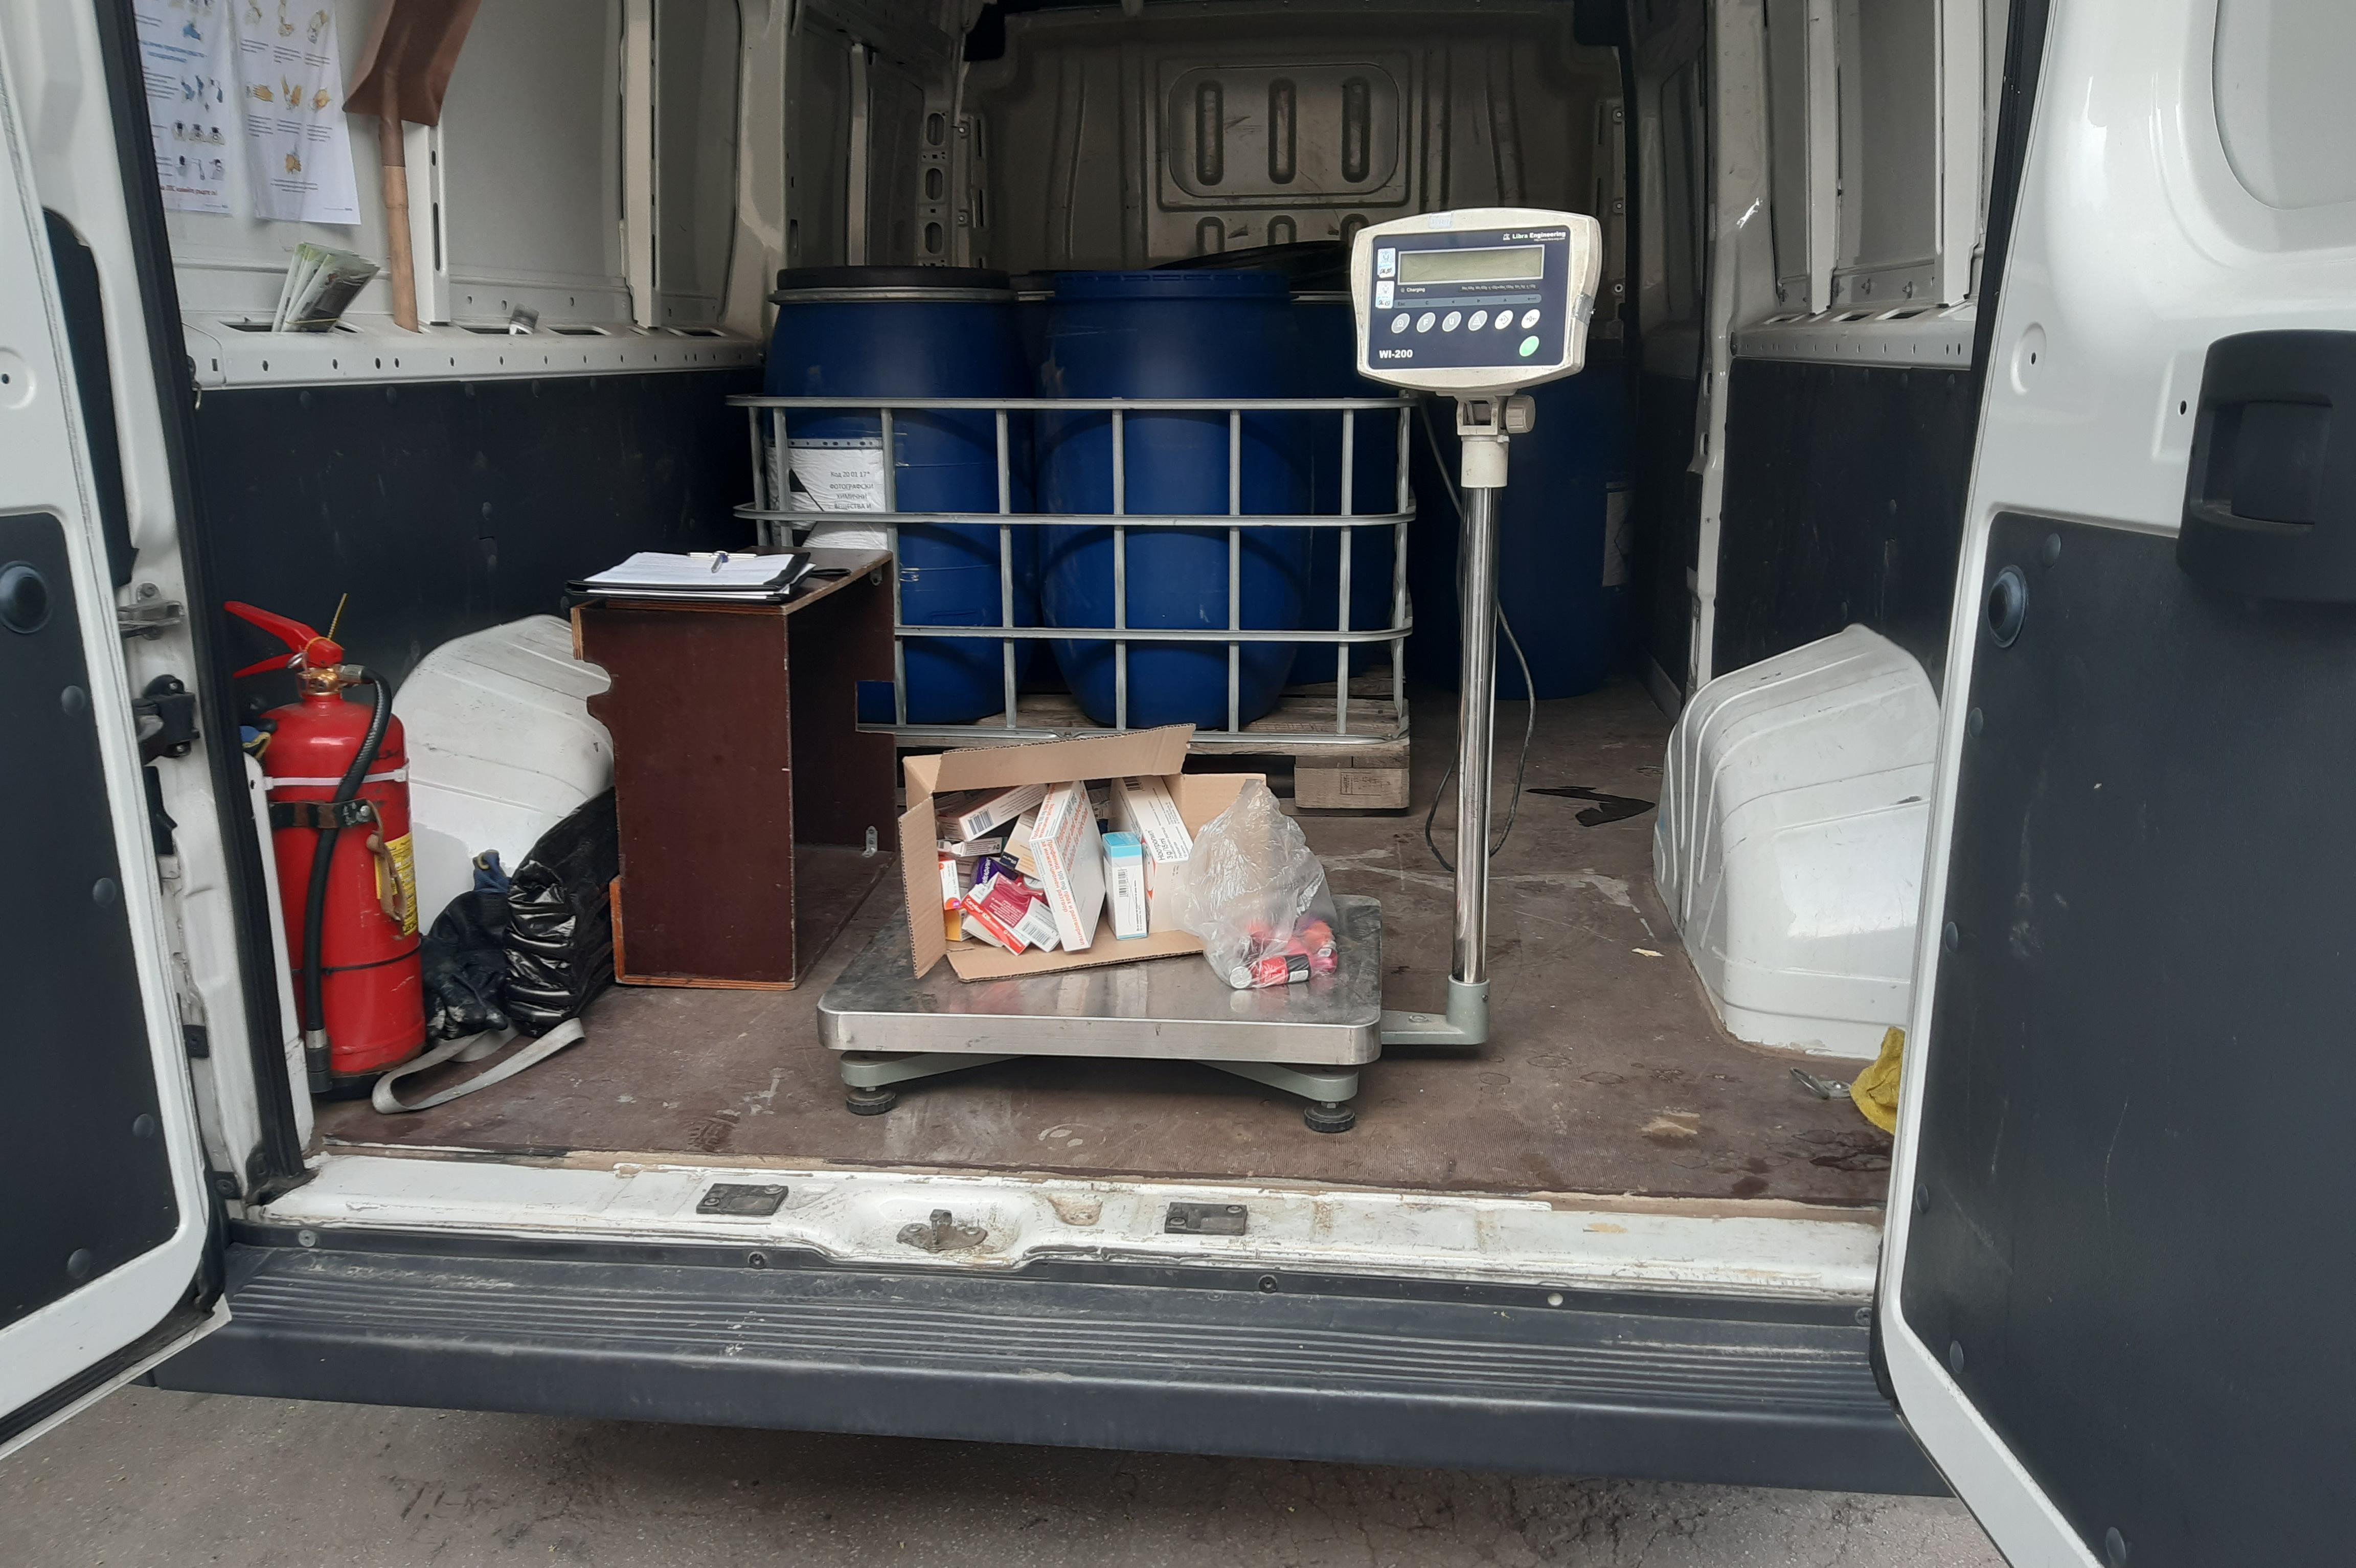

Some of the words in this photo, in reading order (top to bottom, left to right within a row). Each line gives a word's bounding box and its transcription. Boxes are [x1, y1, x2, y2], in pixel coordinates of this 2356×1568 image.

[1379, 349, 1413, 359] WI-200
[1148, 830, 1165, 861] Ноотропил
[1043, 848, 1060, 889] инжекционен
[1055, 889, 1068, 913] разтвор
[1059, 880, 1067, 890] mg
[1063, 891, 1072, 905] прах
[1070, 910, 1085, 945] разтворител
